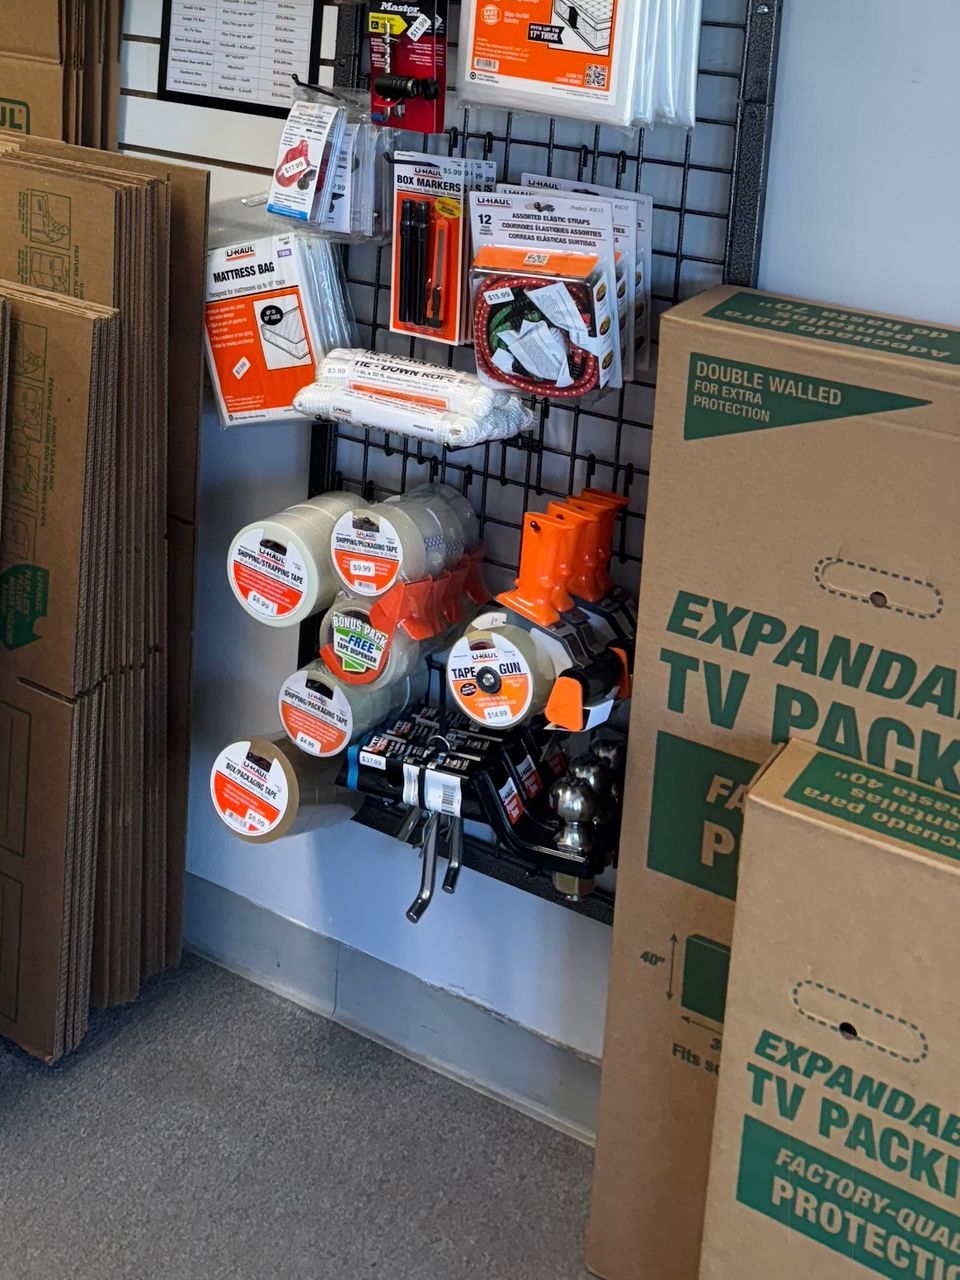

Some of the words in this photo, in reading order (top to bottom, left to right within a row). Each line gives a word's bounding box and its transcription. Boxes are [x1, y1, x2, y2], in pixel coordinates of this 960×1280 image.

[380, 1, 420, 13] Master
[443, 168, 462, 176] $5.99
[397, 175, 414, 185] BOX
[417, 176, 461, 193] MARKERS
[478, 214, 491, 224] 12
[542, 215, 566, 223] ELASTIC
[567, 218, 590, 226] STRAPS
[502, 222, 534, 230] COURROIES
[570, 229, 602, 237] ASSORTIES
[567, 238, 596, 247] SURTIDAS
[213, 266, 256, 283] MATTRESS
[258, 261, 275, 274] BAG
[488, 291, 510, 301] $15.99
[757, 301, 809, 315] 70"
[724, 310, 791, 330] para
[773, 311, 914, 341] pantallas
[819, 310, 902, 332] hasta
[796, 324, 952, 359] Adecuado
[912, 327, 949, 339] de
[694, 380, 719, 396] FOR
[721, 383, 763, 405] EXTRA
[696, 360, 763, 390] DOUBLE
[768, 376, 841, 406] WALLED
[693, 395, 770, 422] PROTECTION
[336, 536, 385, 551] SHIPPING/PACKAGING
[385, 546, 398, 554] TAPE
[238, 549, 290, 581] SHIPPING/STRAPPING
[290, 573, 304, 585] TAPE
[333, 615, 362, 634] BONUS
[363, 624, 388, 646] PACK
[337, 642, 350, 653] TAPE
[350, 646, 377, 664] DISPENSER
[452, 666, 476, 679] TAPE
[498, 662, 522, 674] GUN
[284, 689, 335, 721] SHIPPING/PACKAGING
[335, 712, 348, 727] TAPE
[487, 710, 508, 718] $14.99
[225, 763, 264, 794] BOX/PACKAGING
[264, 786, 278, 800] TAPE
[640, 950, 665, 968] 40"
[672, 1043, 702, 1073] Fits
